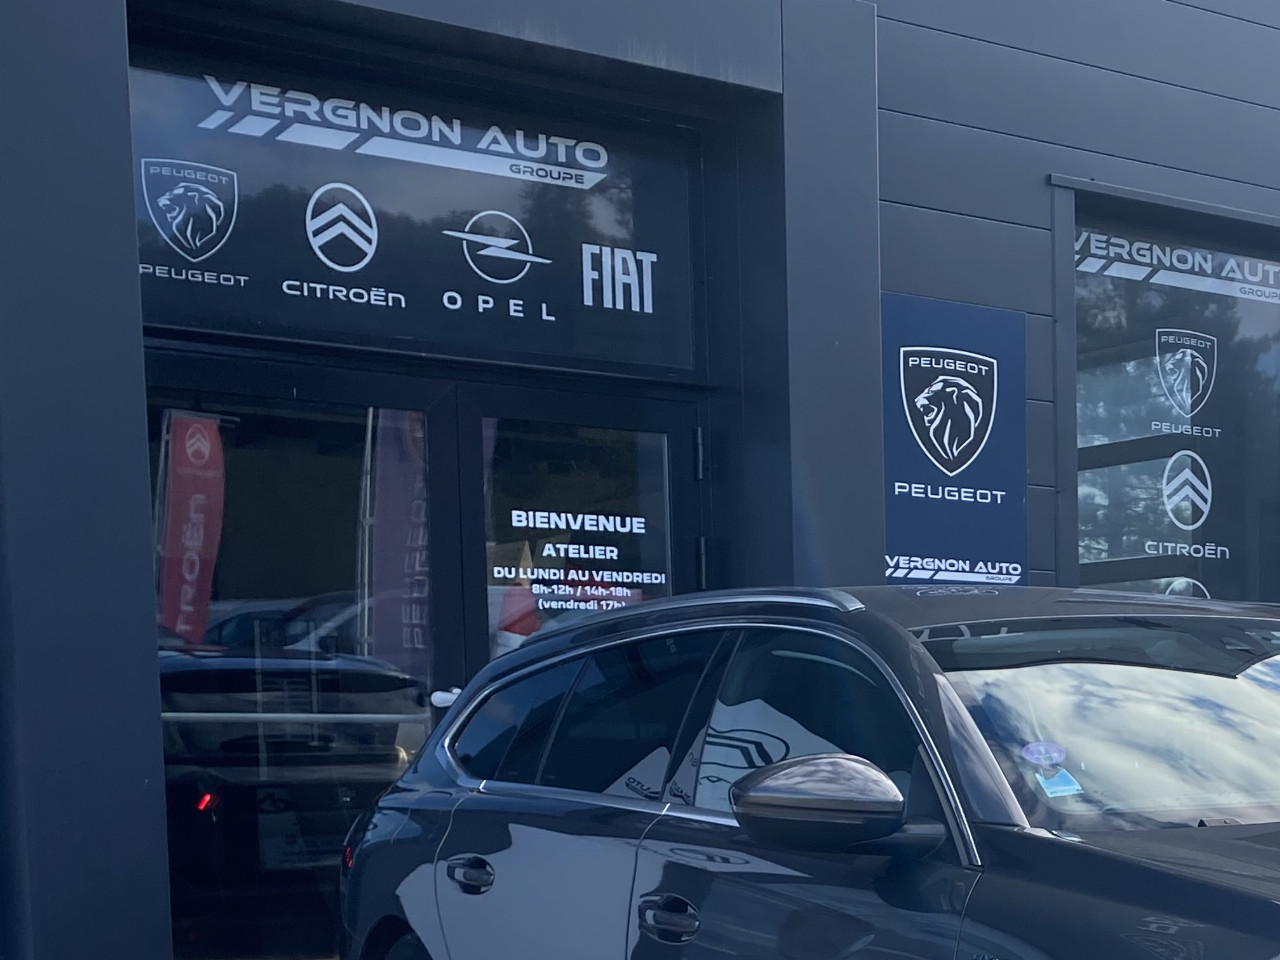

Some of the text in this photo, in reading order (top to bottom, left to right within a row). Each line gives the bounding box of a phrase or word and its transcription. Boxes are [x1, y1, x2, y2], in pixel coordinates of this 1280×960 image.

[203, 74, 609, 168] VERGNON AUTO
[150, 166, 229, 184] PEUGEOT
[509, 164, 585, 185] GROUPE
[138, 263, 249, 287] PEUGEOT
[581, 243, 657, 313] FIAT
[442, 291, 556, 321] OPEL
[1160, 335, 1212, 350] PEUGEOT
[908, 356, 989, 376] PEUGEOT
[1151, 421, 1221, 438] PEUGEOT
[894, 482, 1006, 504] PEUGEOT
[511, 509, 646, 534] BIENVENUE
[542, 543, 619, 560] ATELIER
[493, 566, 666, 584] DU LUNDI AU VENDREDI
[885, 555, 1022, 575] VERGNON AUTO
[532, 583, 574, 595] 8h-12h
[584, 585, 631, 597] 14h-18h
[538, 599, 598, 610] (vendredi
